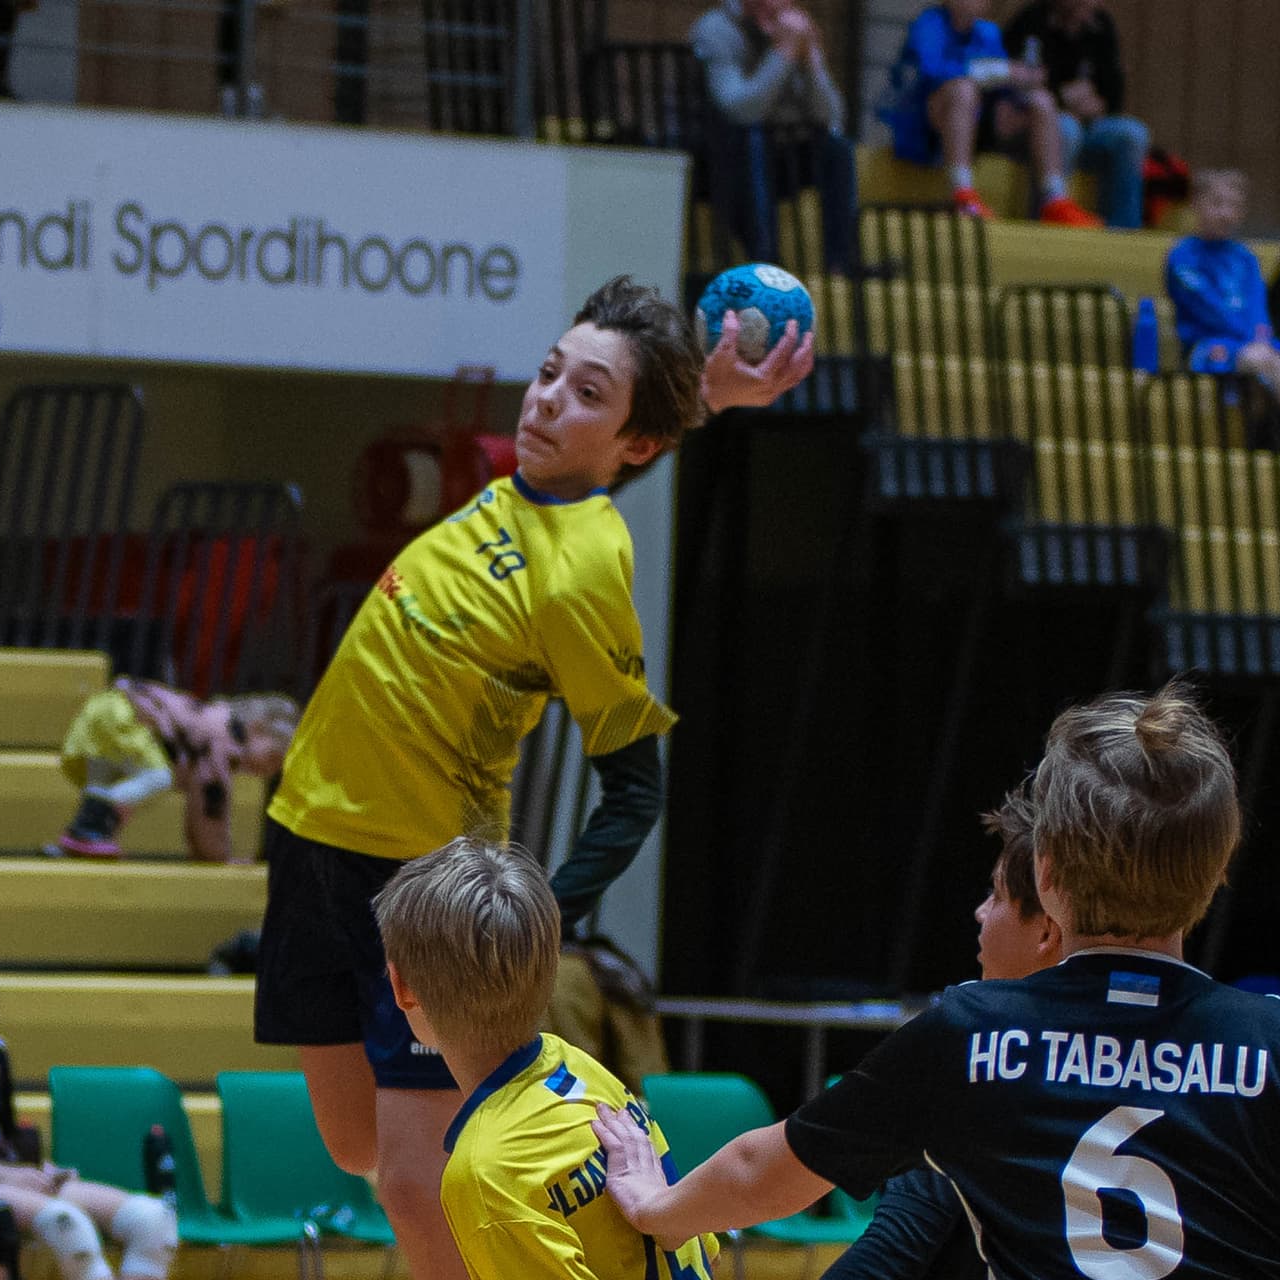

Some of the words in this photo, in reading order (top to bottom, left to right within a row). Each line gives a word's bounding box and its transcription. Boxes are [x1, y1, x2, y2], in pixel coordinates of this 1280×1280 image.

[115, 201, 518, 303] Spordihoone
[969, 1030, 1027, 1083] HC
[1041, 1031, 1268, 1097] TABASALU
